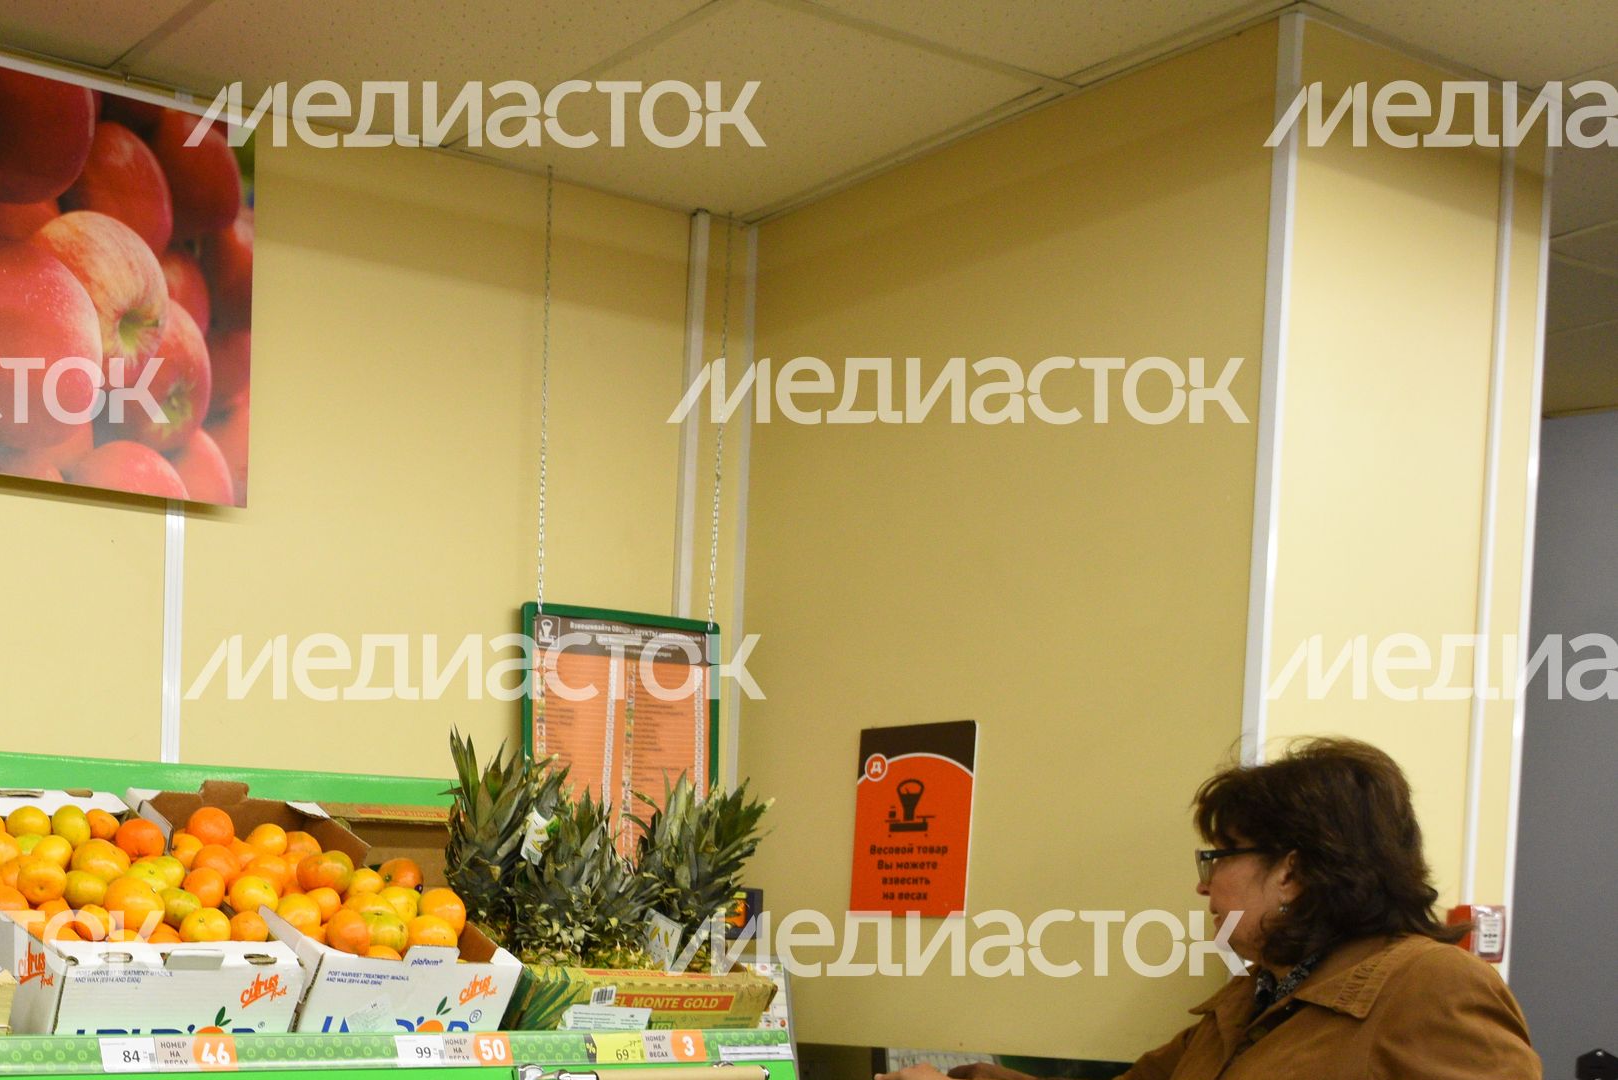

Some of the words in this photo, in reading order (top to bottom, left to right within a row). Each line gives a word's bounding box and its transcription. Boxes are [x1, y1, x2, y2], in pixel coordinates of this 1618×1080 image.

[870, 844, 913, 855] Весовой
[917, 845, 948, 855] товар
[877, 860, 893, 870] Вы
[896, 860, 938, 870] можете
[881, 876, 931, 885] взвесить
[883, 892, 894, 900] на
[898, 891, 928, 900] весах
[240, 973, 279, 1004] citrus
[459, 974, 492, 1003] citrus
[632, 997, 680, 1009] MONTE
[683, 997, 719, 1010] GOLD
[479, 1039, 506, 1061] 50
[682, 1035, 695, 1057] 3
[123, 1050, 140, 1063] 84
[201, 1042, 231, 1066] 46
[416, 1047, 431, 1059] 99
[616, 1049, 629, 1061] 69
